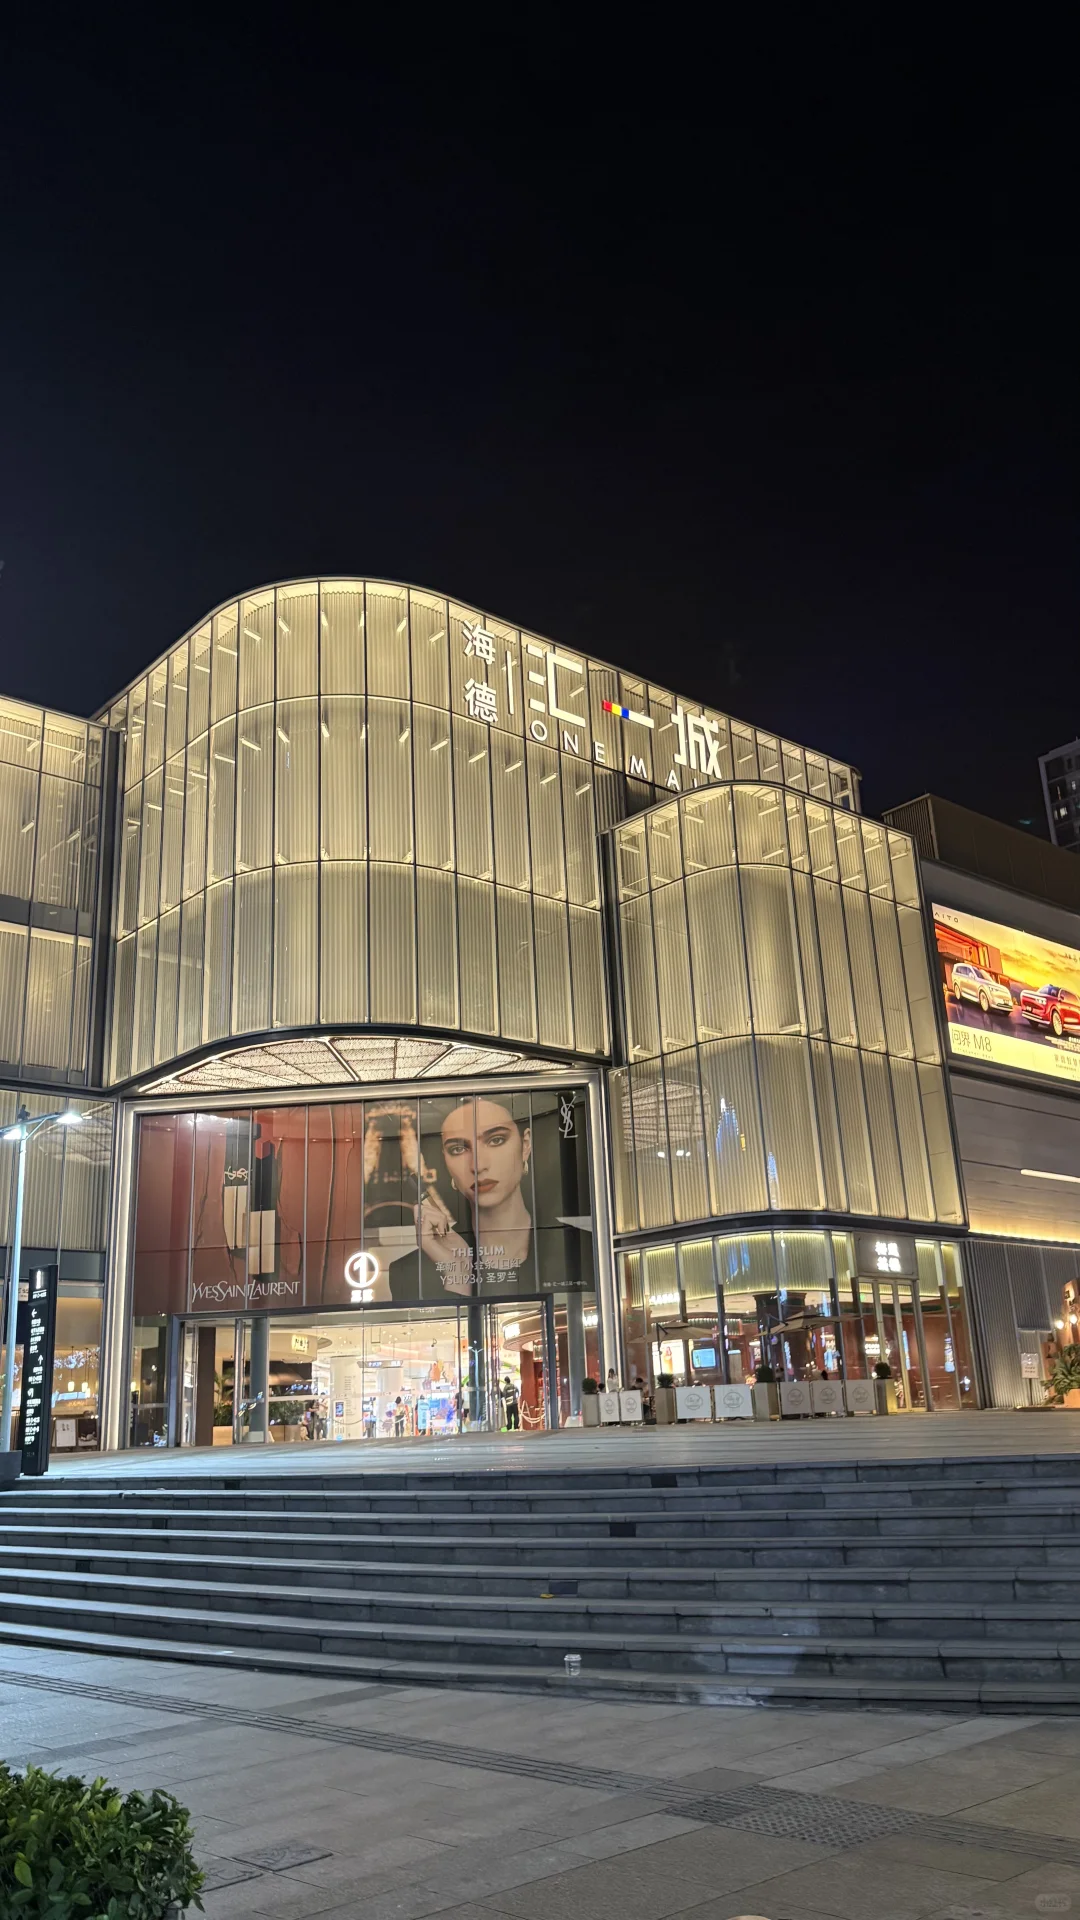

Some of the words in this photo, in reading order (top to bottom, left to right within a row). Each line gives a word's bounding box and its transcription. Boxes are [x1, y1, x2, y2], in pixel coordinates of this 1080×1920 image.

[530, 719, 606, 764] ONE
[973, 1034, 992, 1052] M8
[452, 1247, 474, 1258] THE
[478, 1245, 505, 1256] SLIM
[486, 1271, 518, 1283] 圣罗兰
